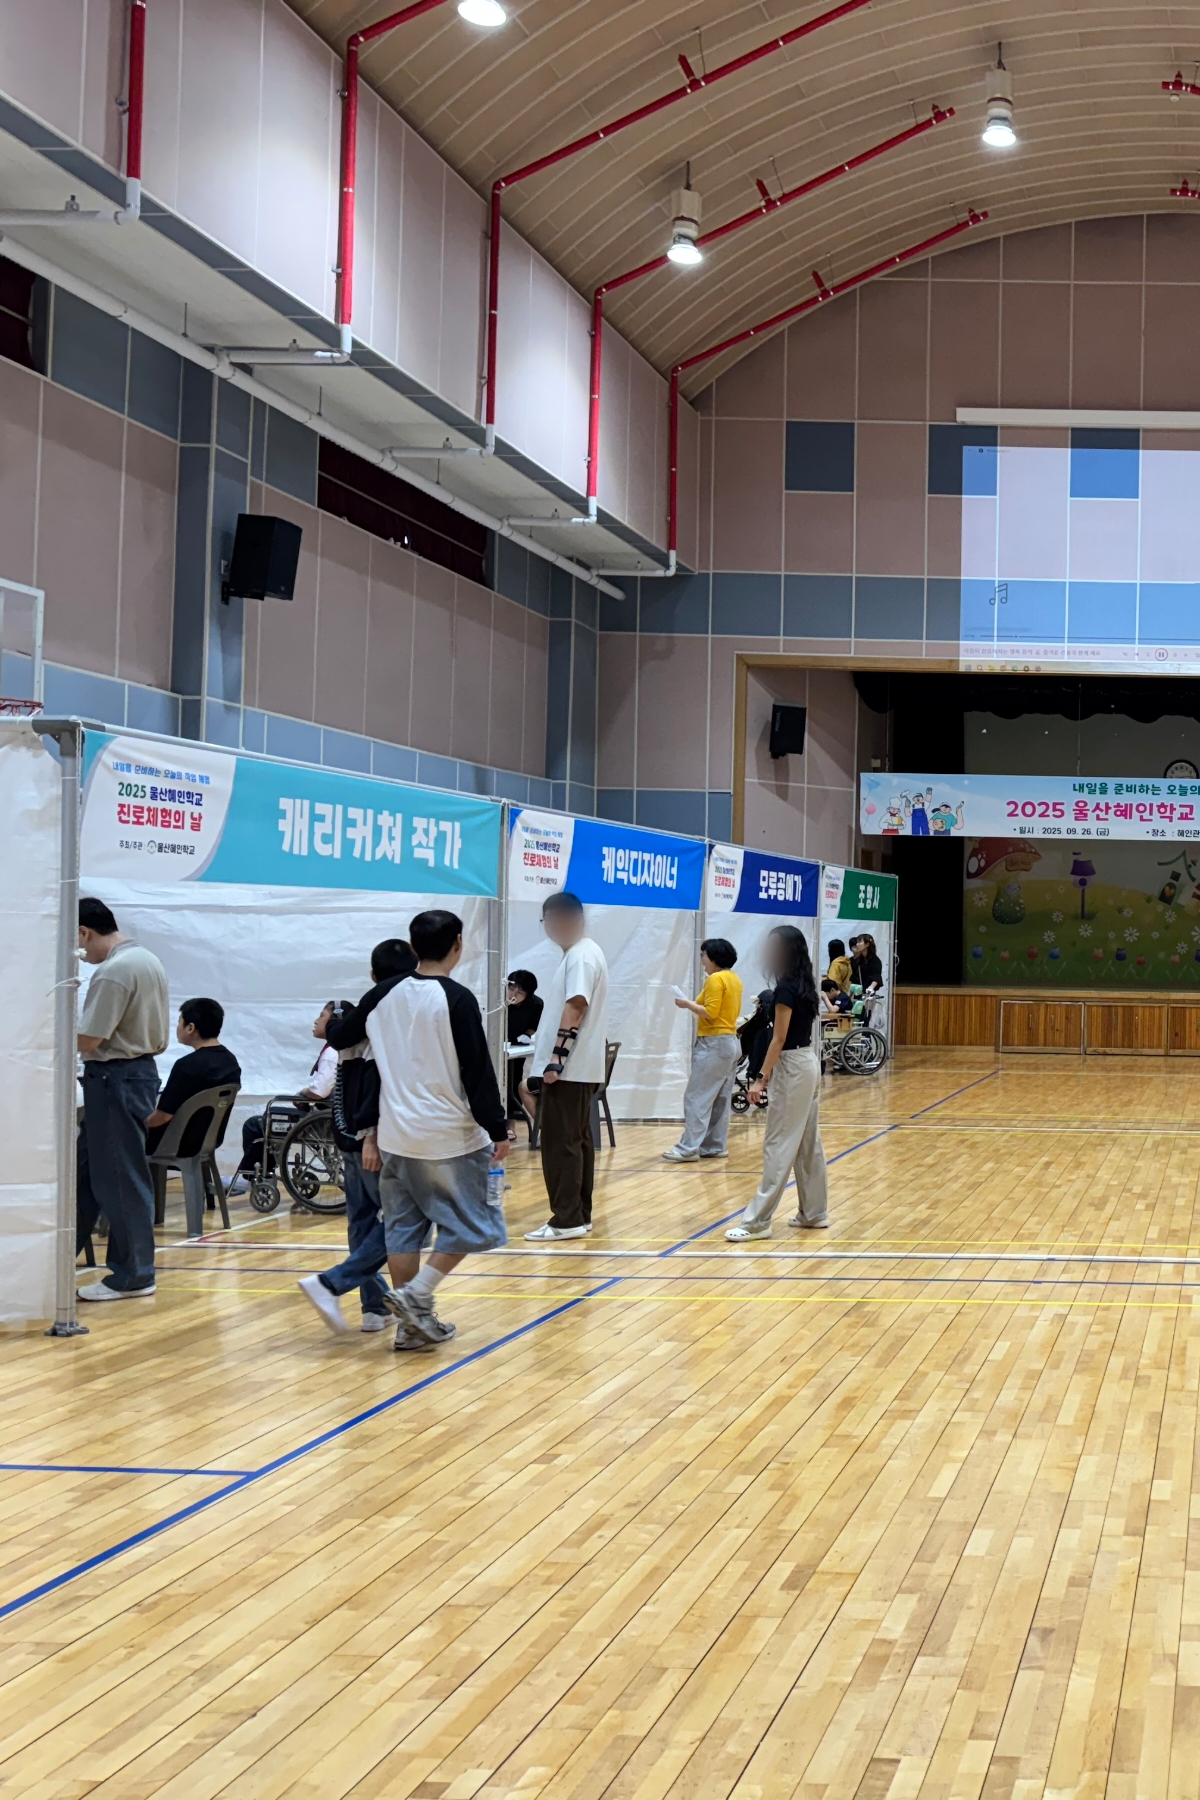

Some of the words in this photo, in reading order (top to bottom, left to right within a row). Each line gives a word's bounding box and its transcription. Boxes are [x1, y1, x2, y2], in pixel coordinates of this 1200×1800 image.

[118, 782, 147, 799] 2025
[150, 786, 203, 807] 울산혜인학교
[1072, 782, 1109, 795] 내일을
[1113, 784, 1162, 796] 준비하는
[1166, 785, 1200, 796] 오늘의
[117, 803, 186, 830] 진로체험의
[190, 812, 203, 832] 날
[1006, 800, 1066, 819] 2025
[1072, 800, 1195, 822] 울산혜인학교
[278, 798, 402, 864] 캐리커쳐
[411, 816, 462, 869] 작가
[1018, 826, 1034, 835] 일시
[1096, 827, 1110, 837] (금)
[1151, 828, 1167, 837] 장소
[1177, 829, 1200, 838] 혜인관
[601, 846, 678, 890] 케익디자이너
[758, 869, 802, 903] 모루공예가
